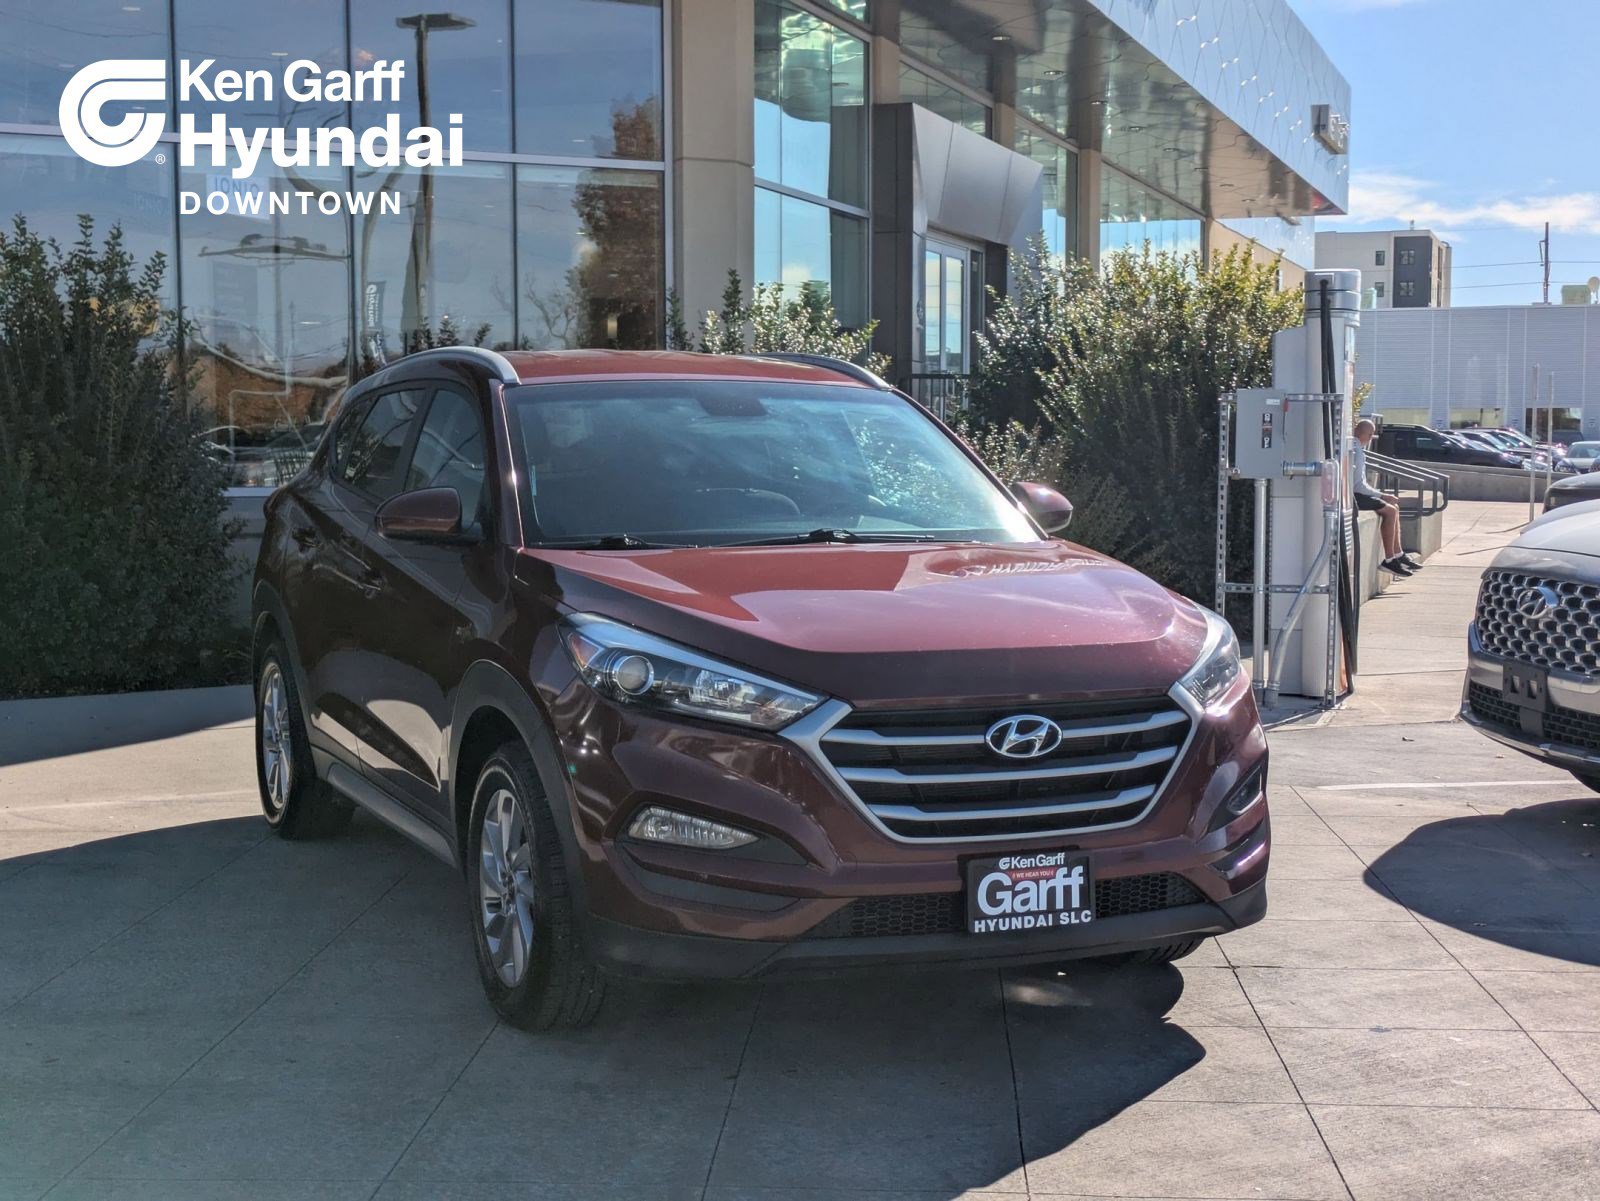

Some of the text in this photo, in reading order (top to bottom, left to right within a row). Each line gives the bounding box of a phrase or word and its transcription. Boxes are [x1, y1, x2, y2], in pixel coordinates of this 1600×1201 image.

[1011, 852, 1065, 869] Ken Garff
[977, 866, 1084, 916] Garff
[974, 909, 1092, 933] HYUNDAI SLC
